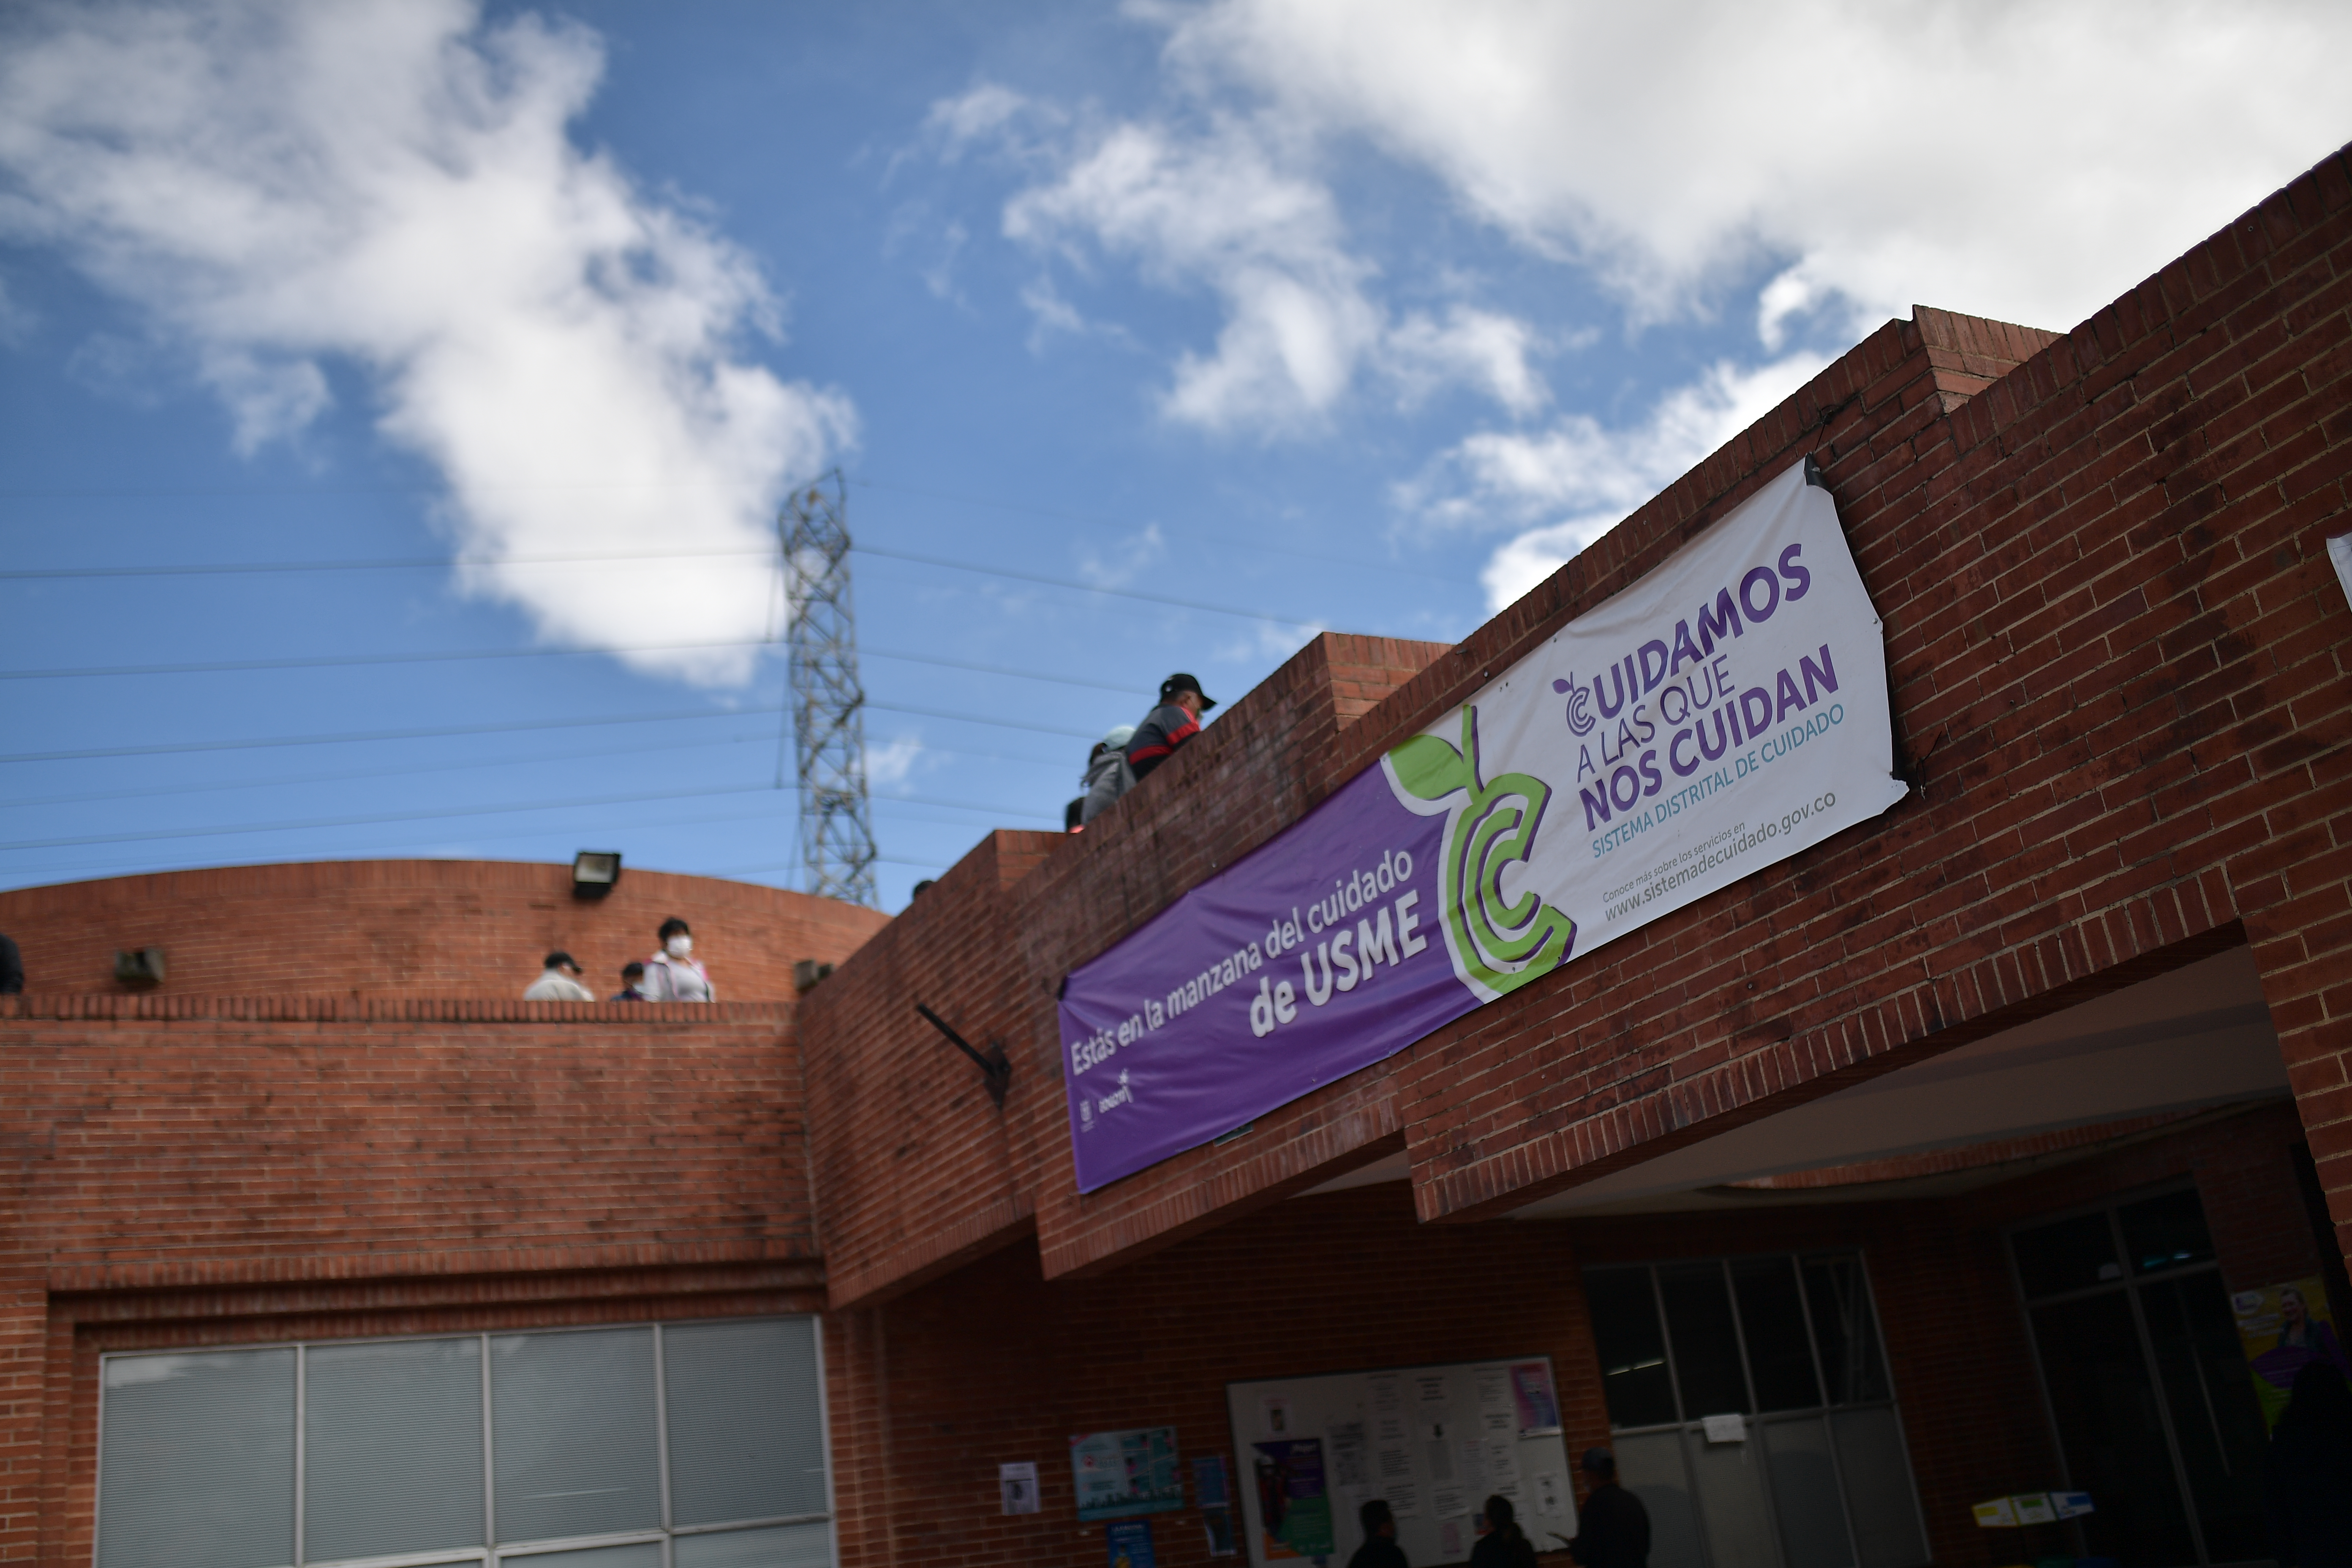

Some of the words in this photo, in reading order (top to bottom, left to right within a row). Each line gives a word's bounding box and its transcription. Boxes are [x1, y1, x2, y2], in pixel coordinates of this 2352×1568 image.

[1566, 544, 1810, 737] CUIDAMOS
[1577, 744, 1595, 783] A
[1601, 705, 1655, 767] LAS
[1660, 653, 1735, 726] QUE
[1579, 750, 1662, 832] NOS
[1669, 643, 1839, 777] CUIDAN
[1592, 811, 1654, 858] SISTEMA
[1655, 767, 1734, 824] DISTRITAL
[1736, 750, 1759, 779] DE
[1761, 704, 1844, 763] CUIDADO
[1603, 882, 1634, 903] Conoce
[1636, 871, 1652, 887] más
[1654, 857, 1678, 877] sobre
[1679, 851, 1693, 863] los
[1693, 830, 1732, 856] servicios
[1734, 822, 1745, 835] en
[1605, 792, 1836, 922] www.sistemadecuidado.gov.co
[1070, 1027, 1116, 1076] Estás
[1117, 1013, 1143, 1047] en
[1144, 999, 1165, 1032] la
[1166, 942, 1263, 1019] manzana
[1265, 906, 1305, 959] del
[1307, 849, 1412, 934] cuidado
[1250, 976, 1298, 1038] de
[1300, 889, 1428, 1007] USME
